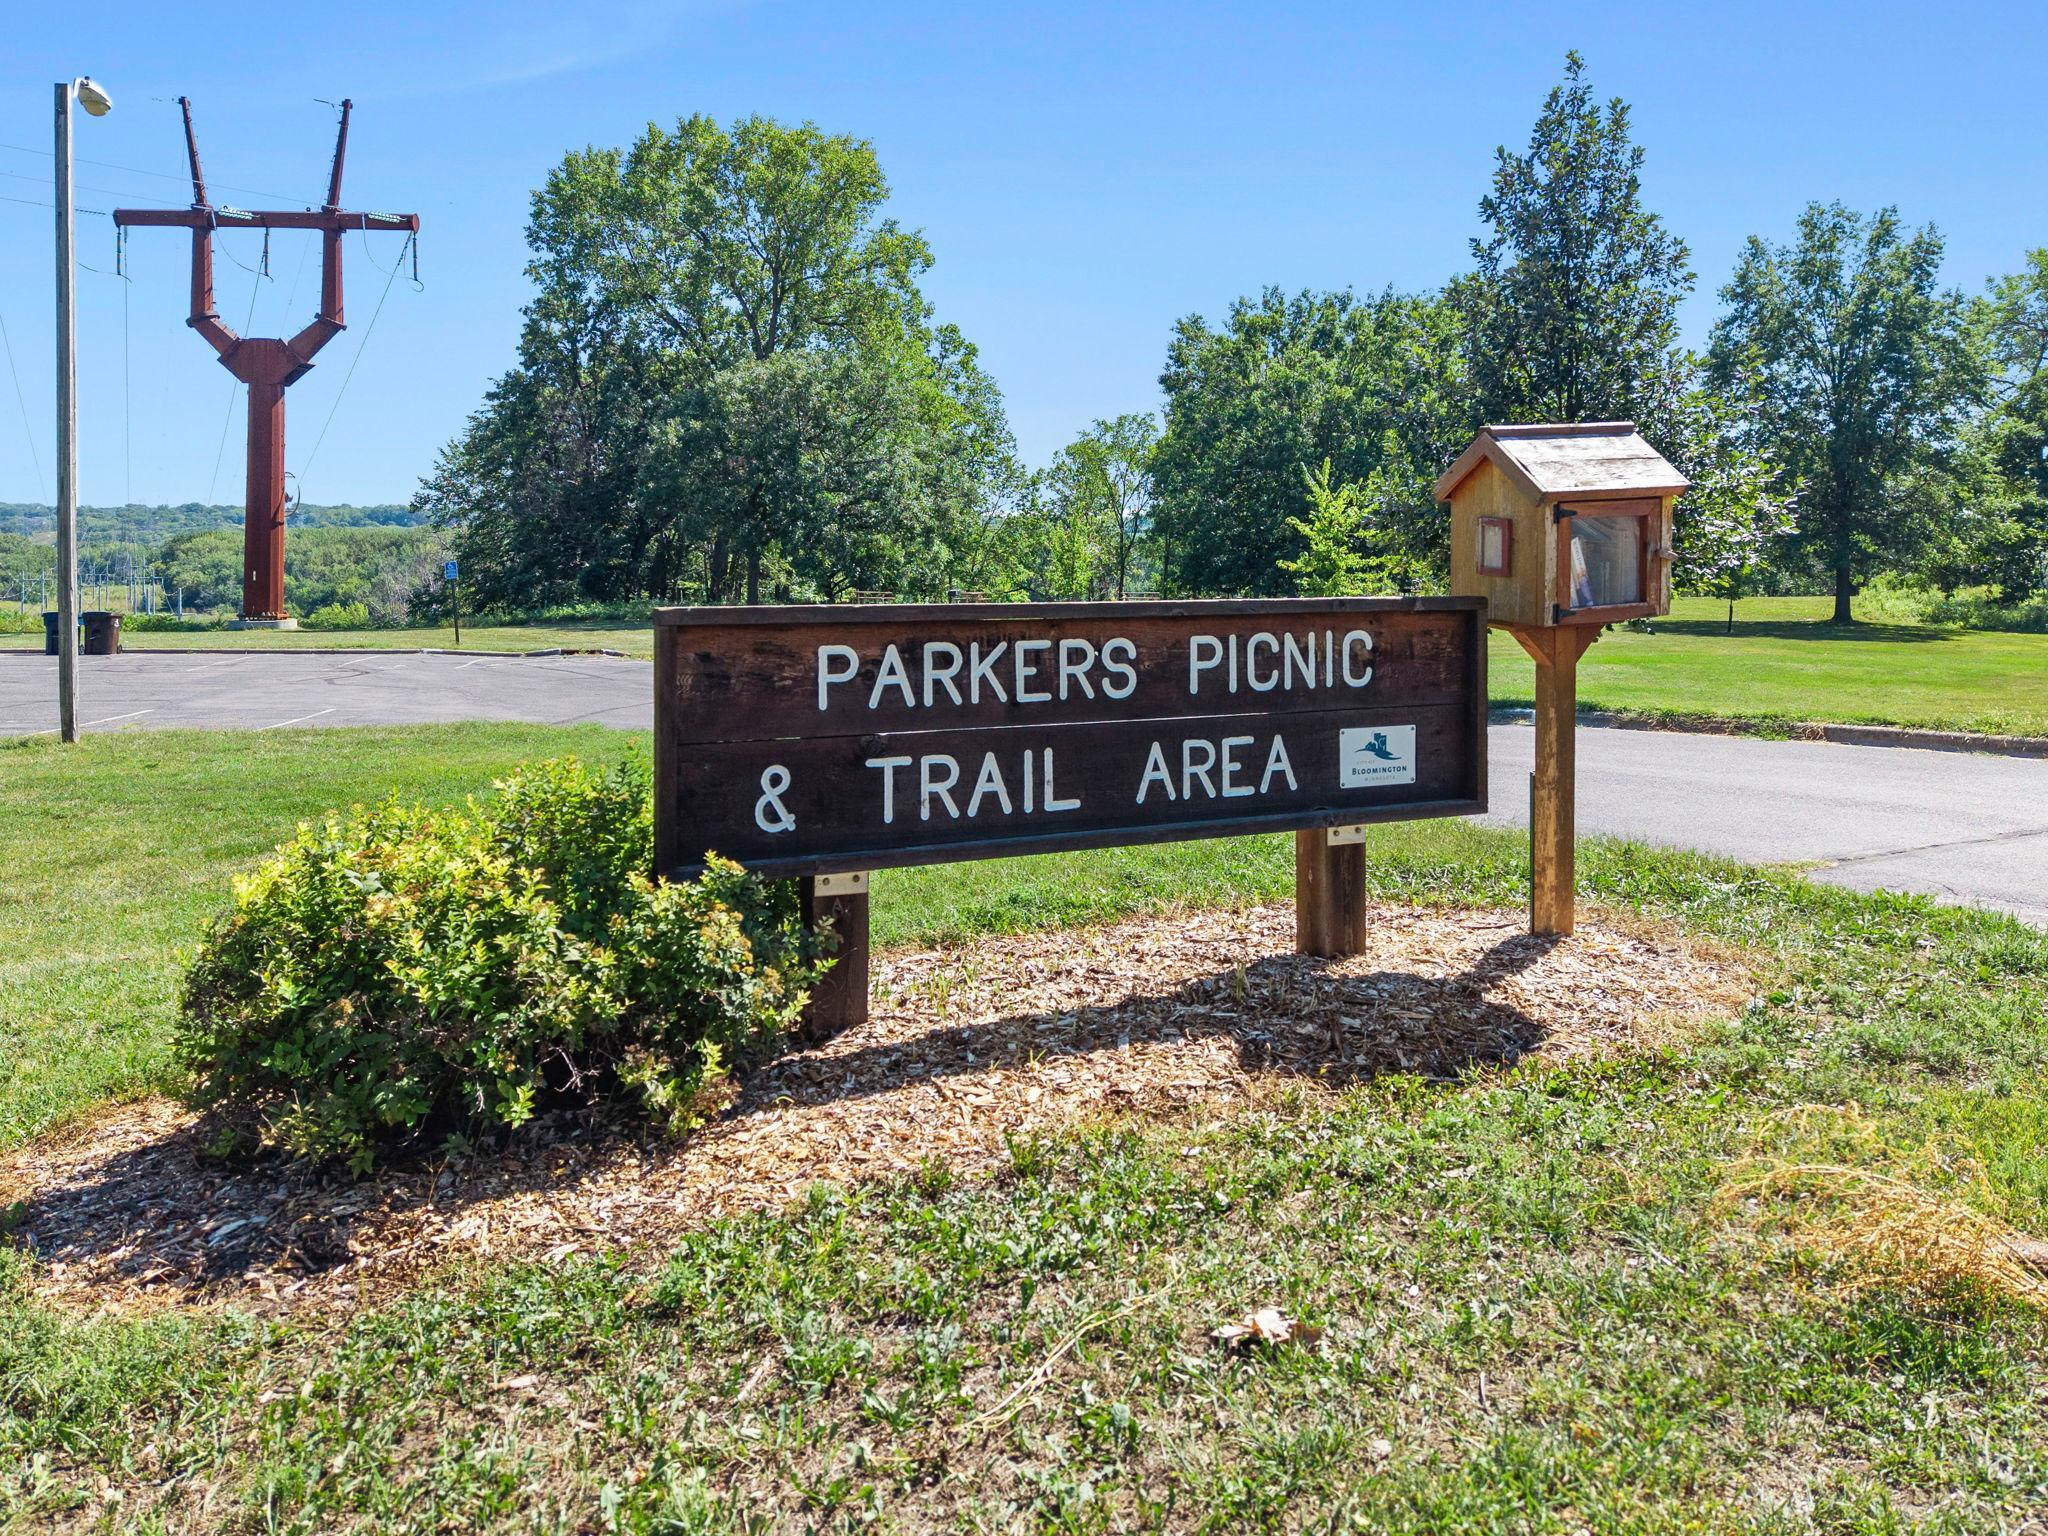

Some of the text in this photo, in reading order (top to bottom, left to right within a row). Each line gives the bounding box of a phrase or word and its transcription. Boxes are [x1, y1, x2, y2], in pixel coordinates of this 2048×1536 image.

[817, 629, 1373, 711] PARKERS PICNIC
[754, 734, 1298, 832] & TRAIL AREA
